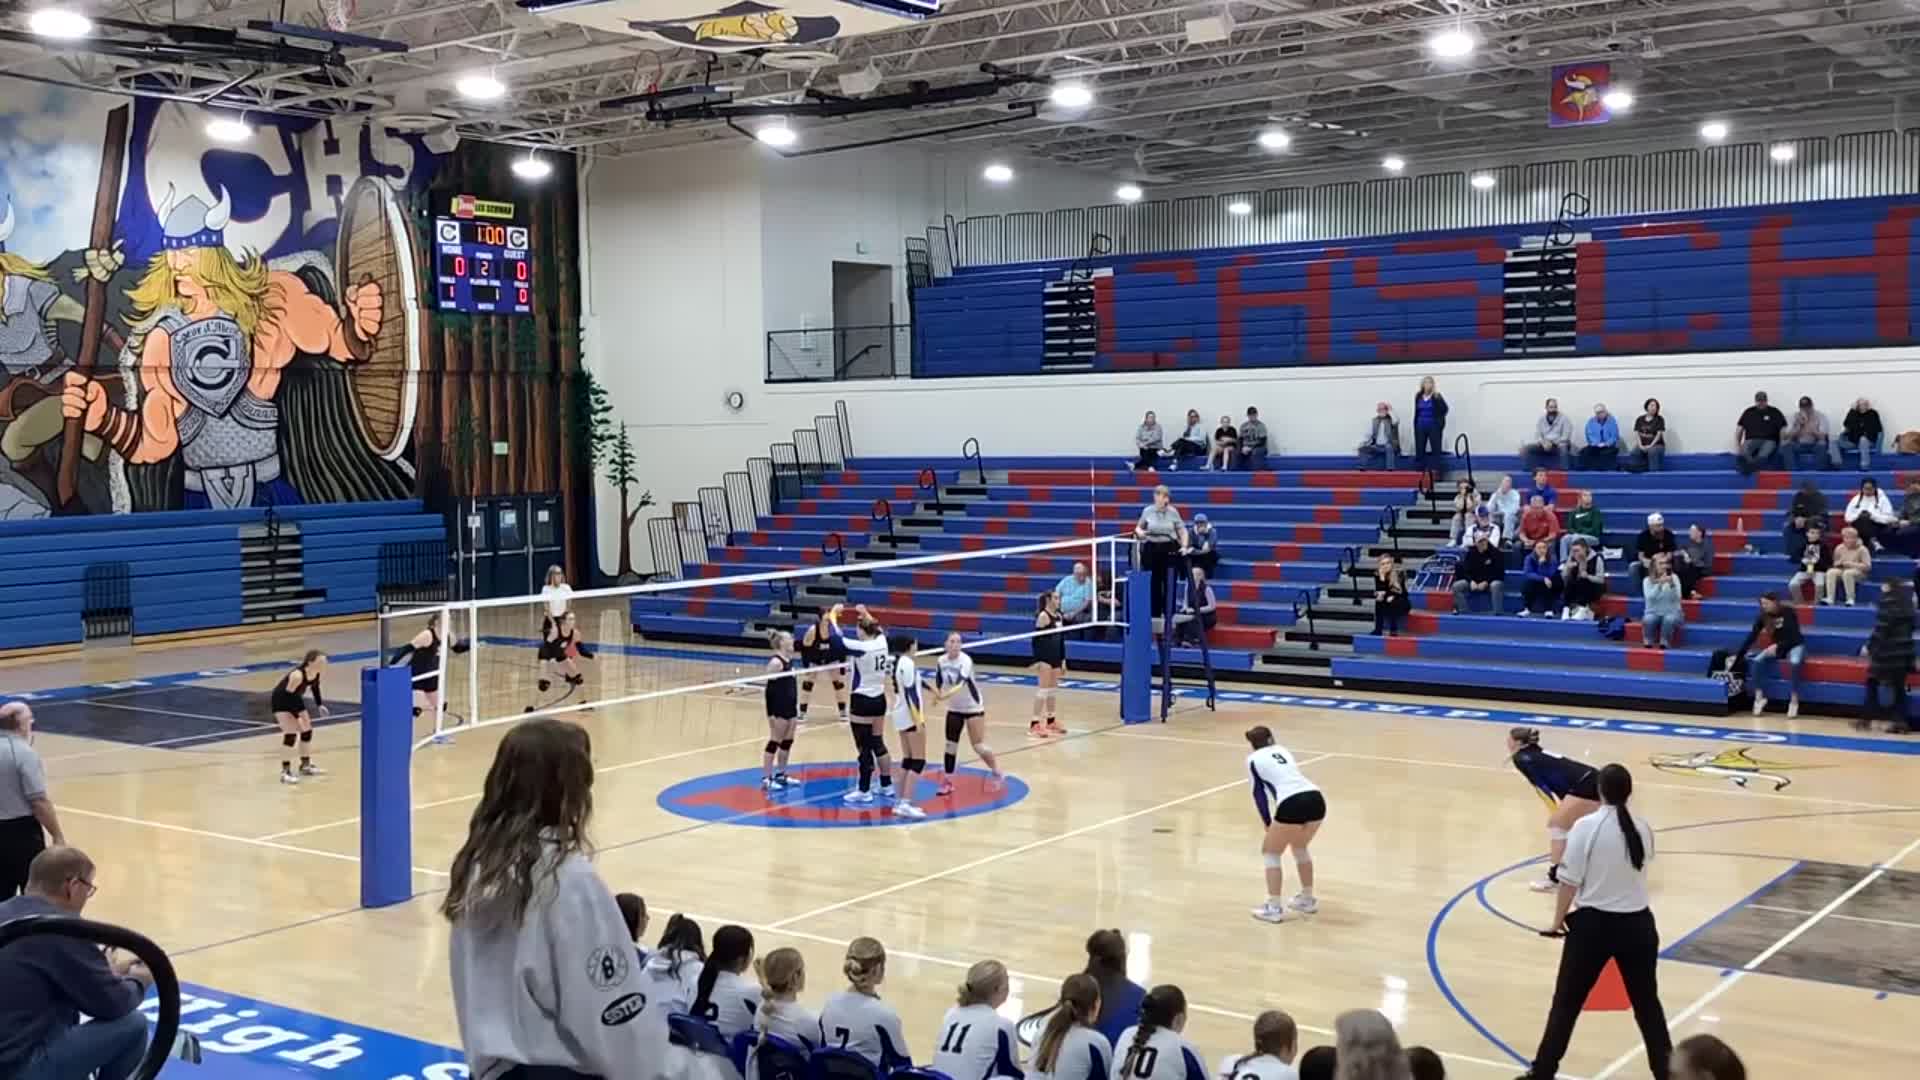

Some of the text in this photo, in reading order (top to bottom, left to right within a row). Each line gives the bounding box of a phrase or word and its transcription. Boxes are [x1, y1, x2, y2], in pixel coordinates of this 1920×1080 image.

[455, 257, 465, 276] 0
[481, 261, 489, 276] 2
[517, 262, 527, 280] 0
[519, 288, 528, 303] 0
[874, 655, 886, 671] 12
[1272, 753, 1287, 764] 9
[941, 1022, 971, 1053] 11
